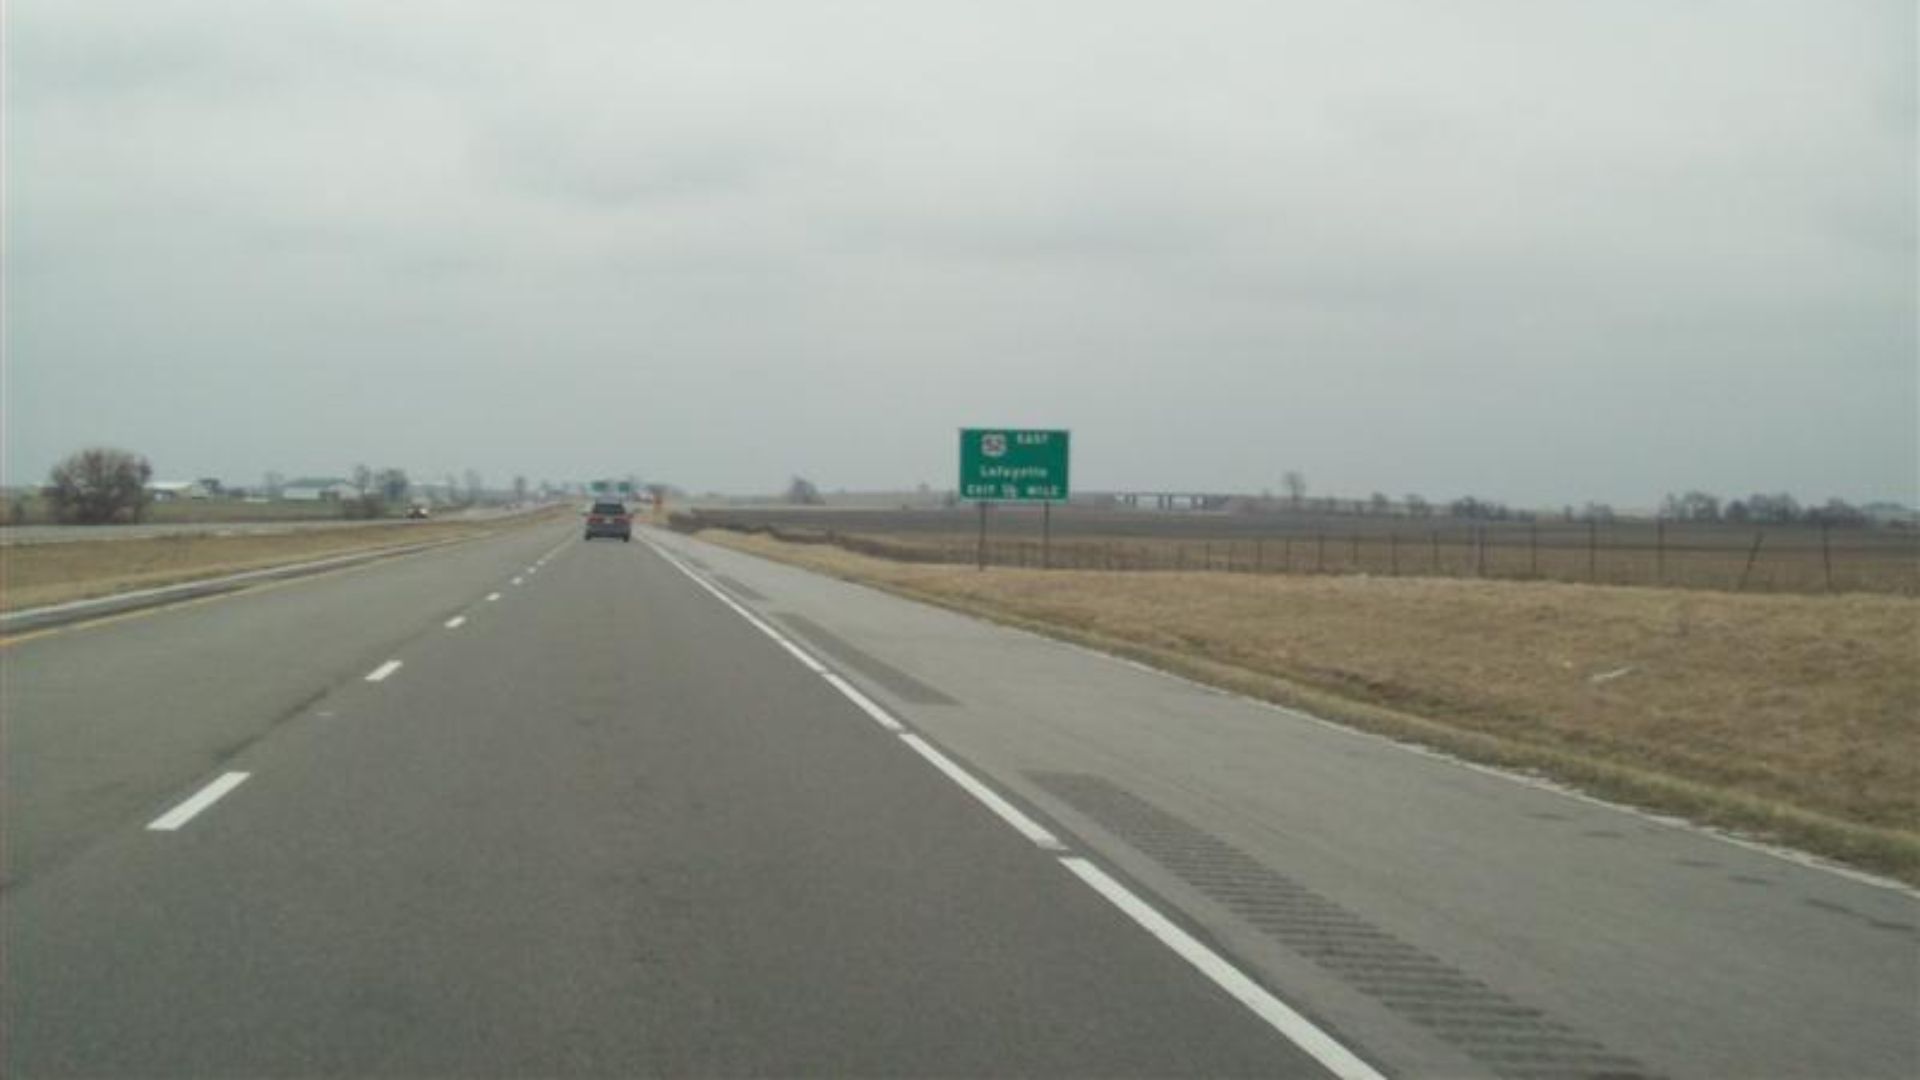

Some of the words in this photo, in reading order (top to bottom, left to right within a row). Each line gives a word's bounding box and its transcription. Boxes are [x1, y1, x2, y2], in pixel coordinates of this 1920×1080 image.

[1017, 433, 1048, 444] EAST
[980, 465, 1048, 481] Lafayette
[966, 484, 995, 496] EXIT
[1027, 485, 1058, 496] MILE
